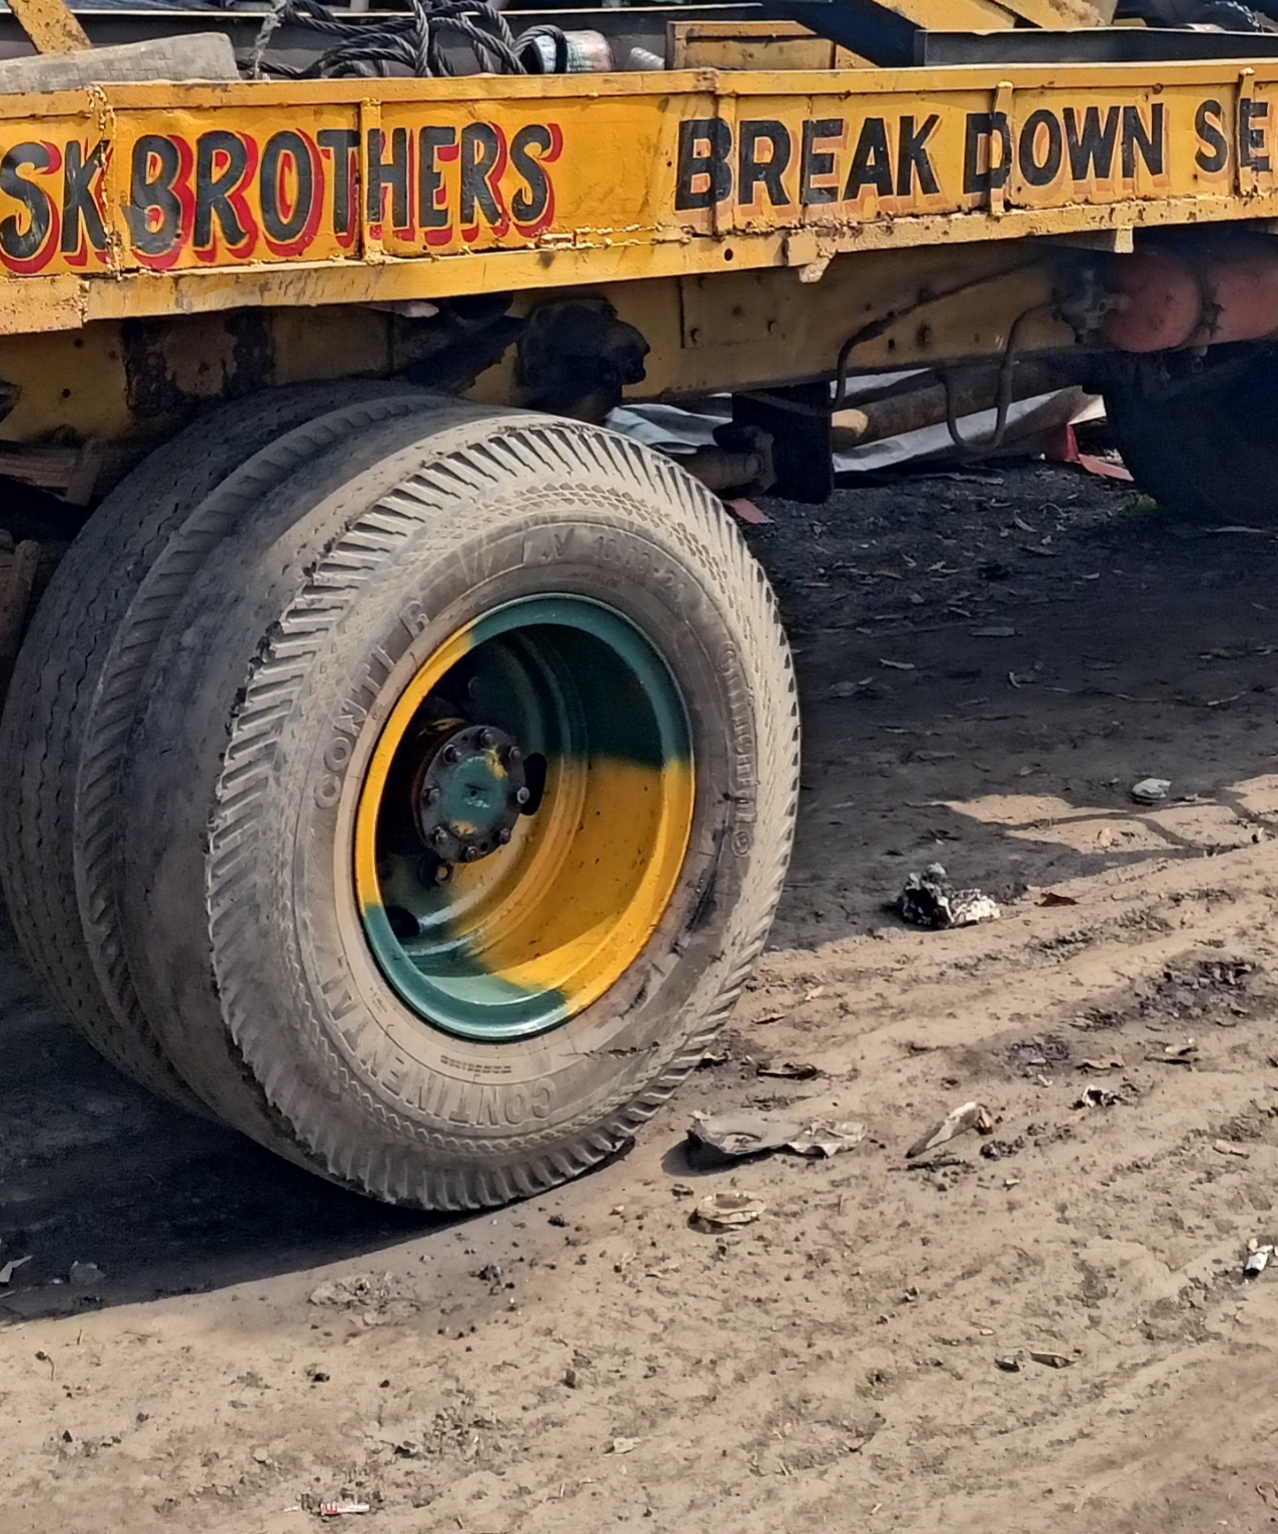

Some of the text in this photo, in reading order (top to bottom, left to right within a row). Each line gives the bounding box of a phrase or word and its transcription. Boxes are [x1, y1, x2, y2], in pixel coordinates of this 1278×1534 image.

[130, 121, 562, 273] BROTHERS
[673, 112, 941, 214] BREAK
[963, 101, 1166, 196] DOWN
[320, 953, 557, 1129] CONTINENTAL
